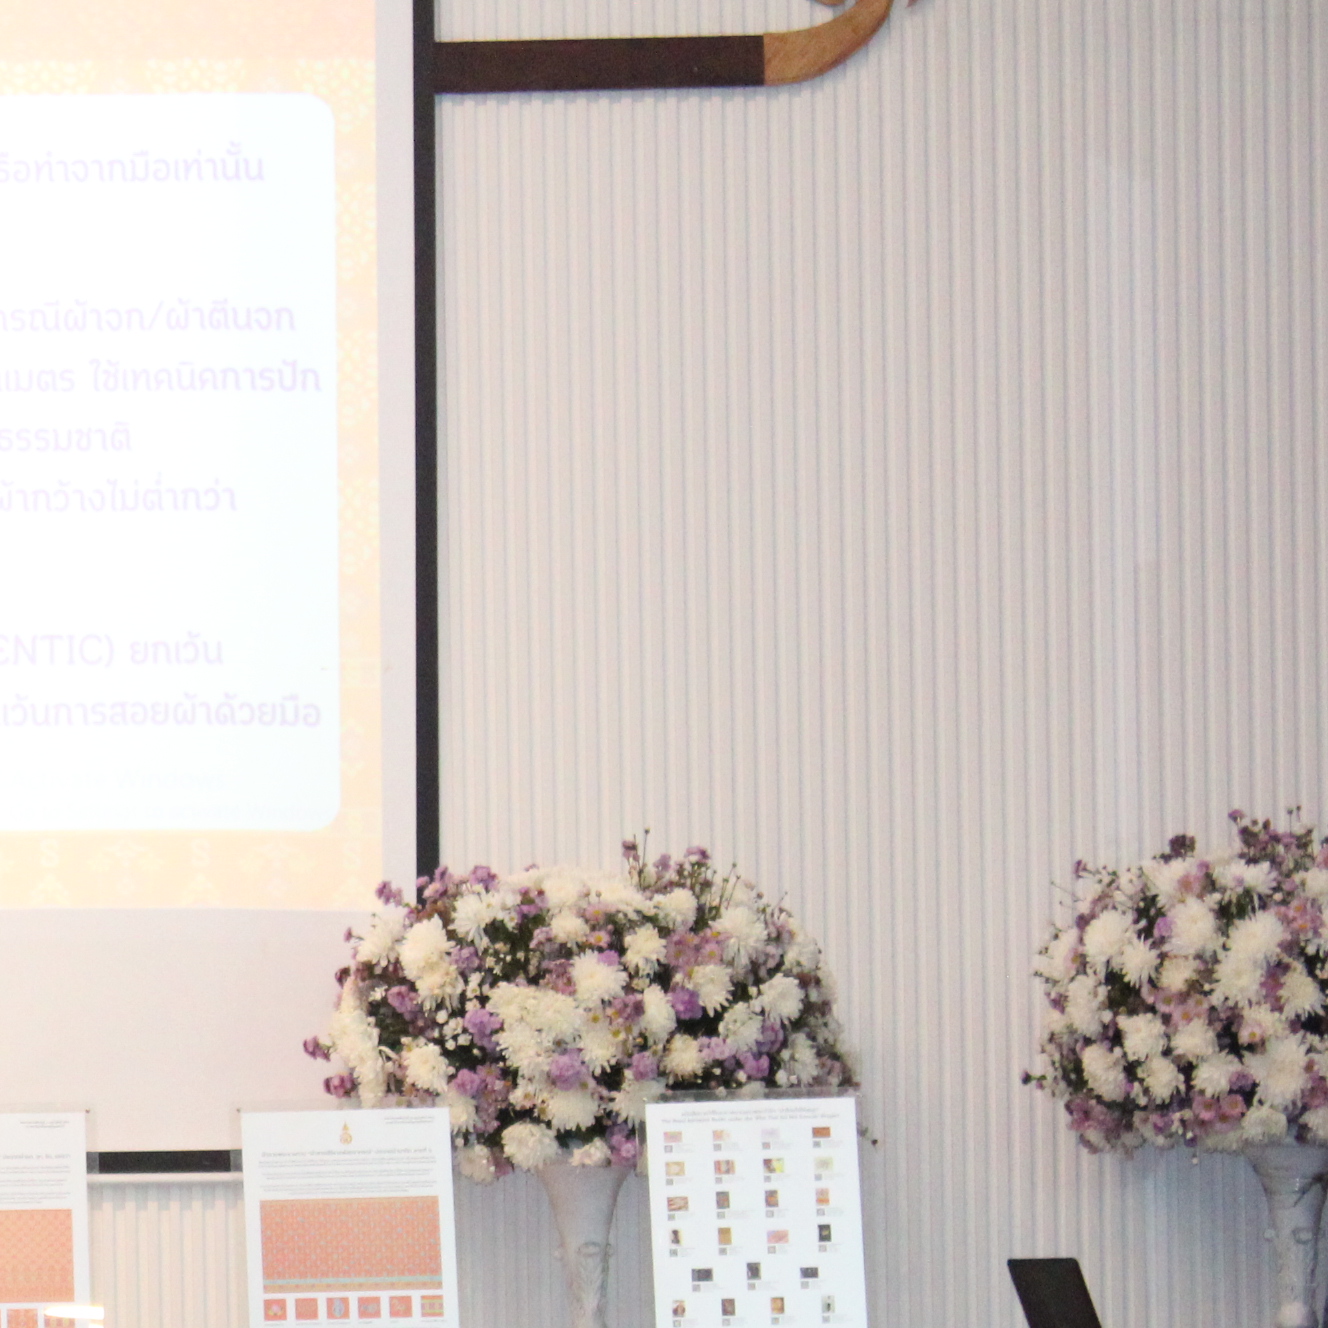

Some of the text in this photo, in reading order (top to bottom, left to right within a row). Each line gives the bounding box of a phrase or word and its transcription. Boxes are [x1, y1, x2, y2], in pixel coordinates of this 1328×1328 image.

[88, 358, 322, 393] ใช้เทคนิคการปัก
[129, 630, 224, 666] ยกเว้น
